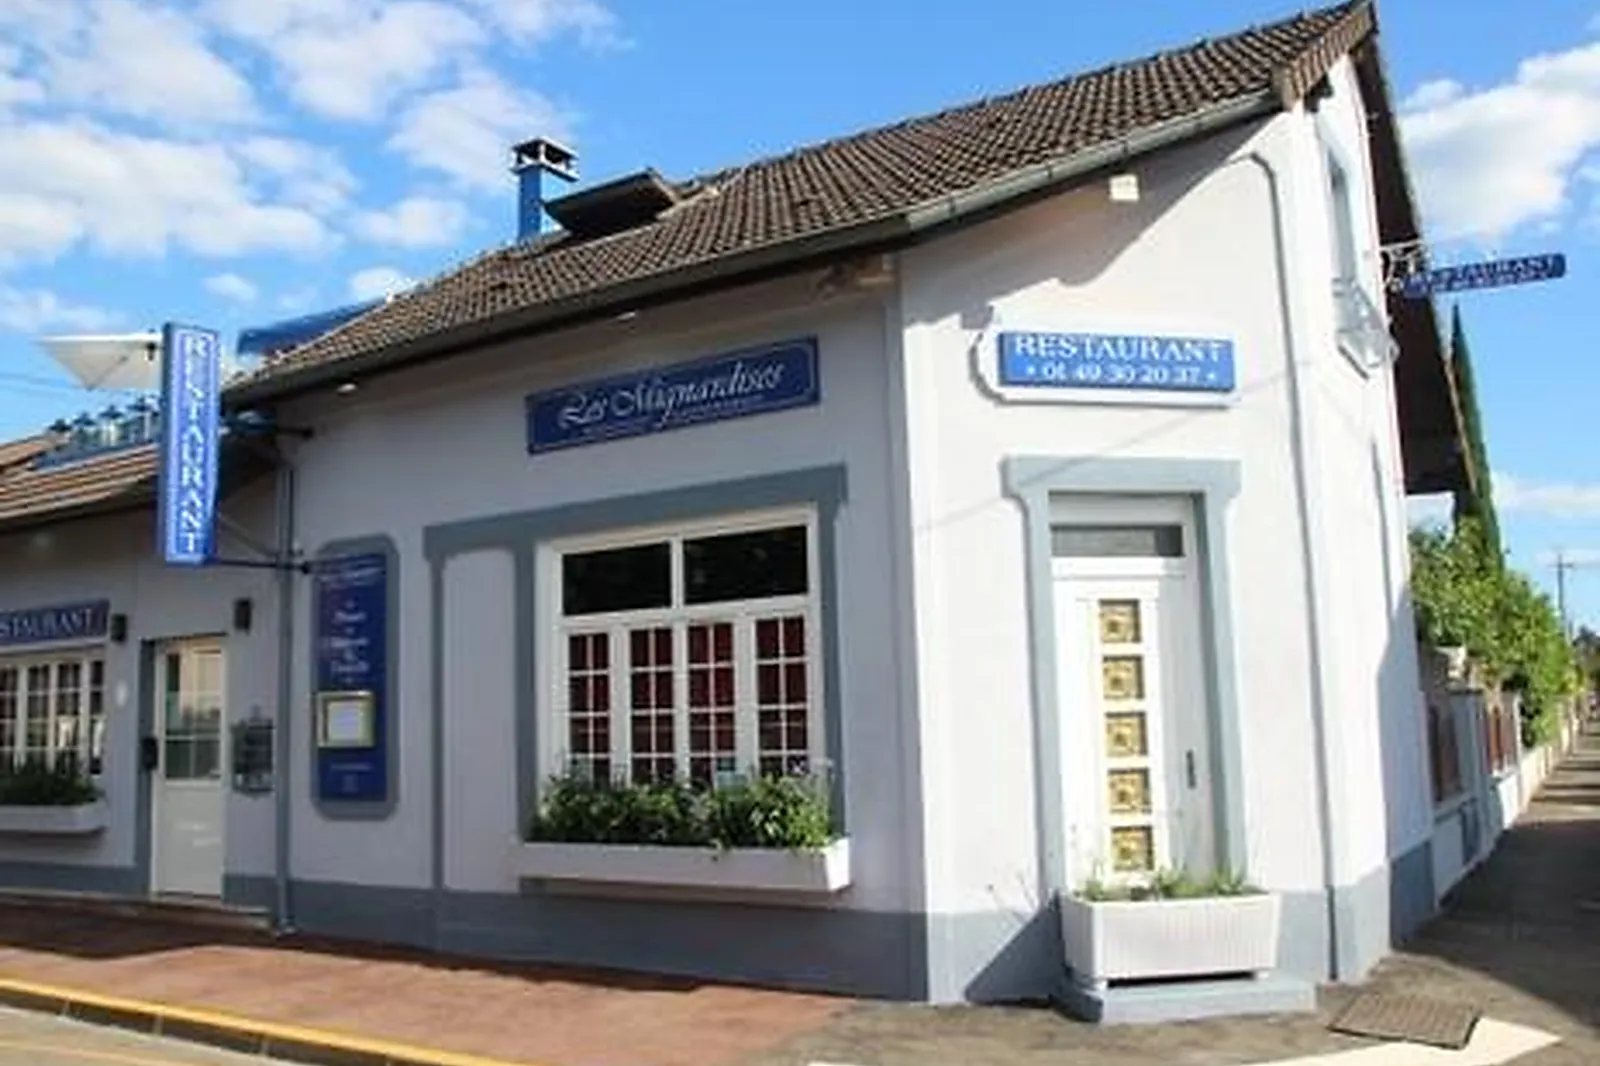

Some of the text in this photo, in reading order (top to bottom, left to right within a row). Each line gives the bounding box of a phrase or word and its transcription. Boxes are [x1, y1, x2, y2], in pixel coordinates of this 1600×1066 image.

[1015, 334, 1224, 362] RESTAURANT
[559, 391, 608, 429] Les
[612, 359, 784, 427] Mignardises
[1140, 365, 1170, 383] 20
[1174, 366, 1203, 384] 37
[180, 336, 209, 552] RESTAURANT
